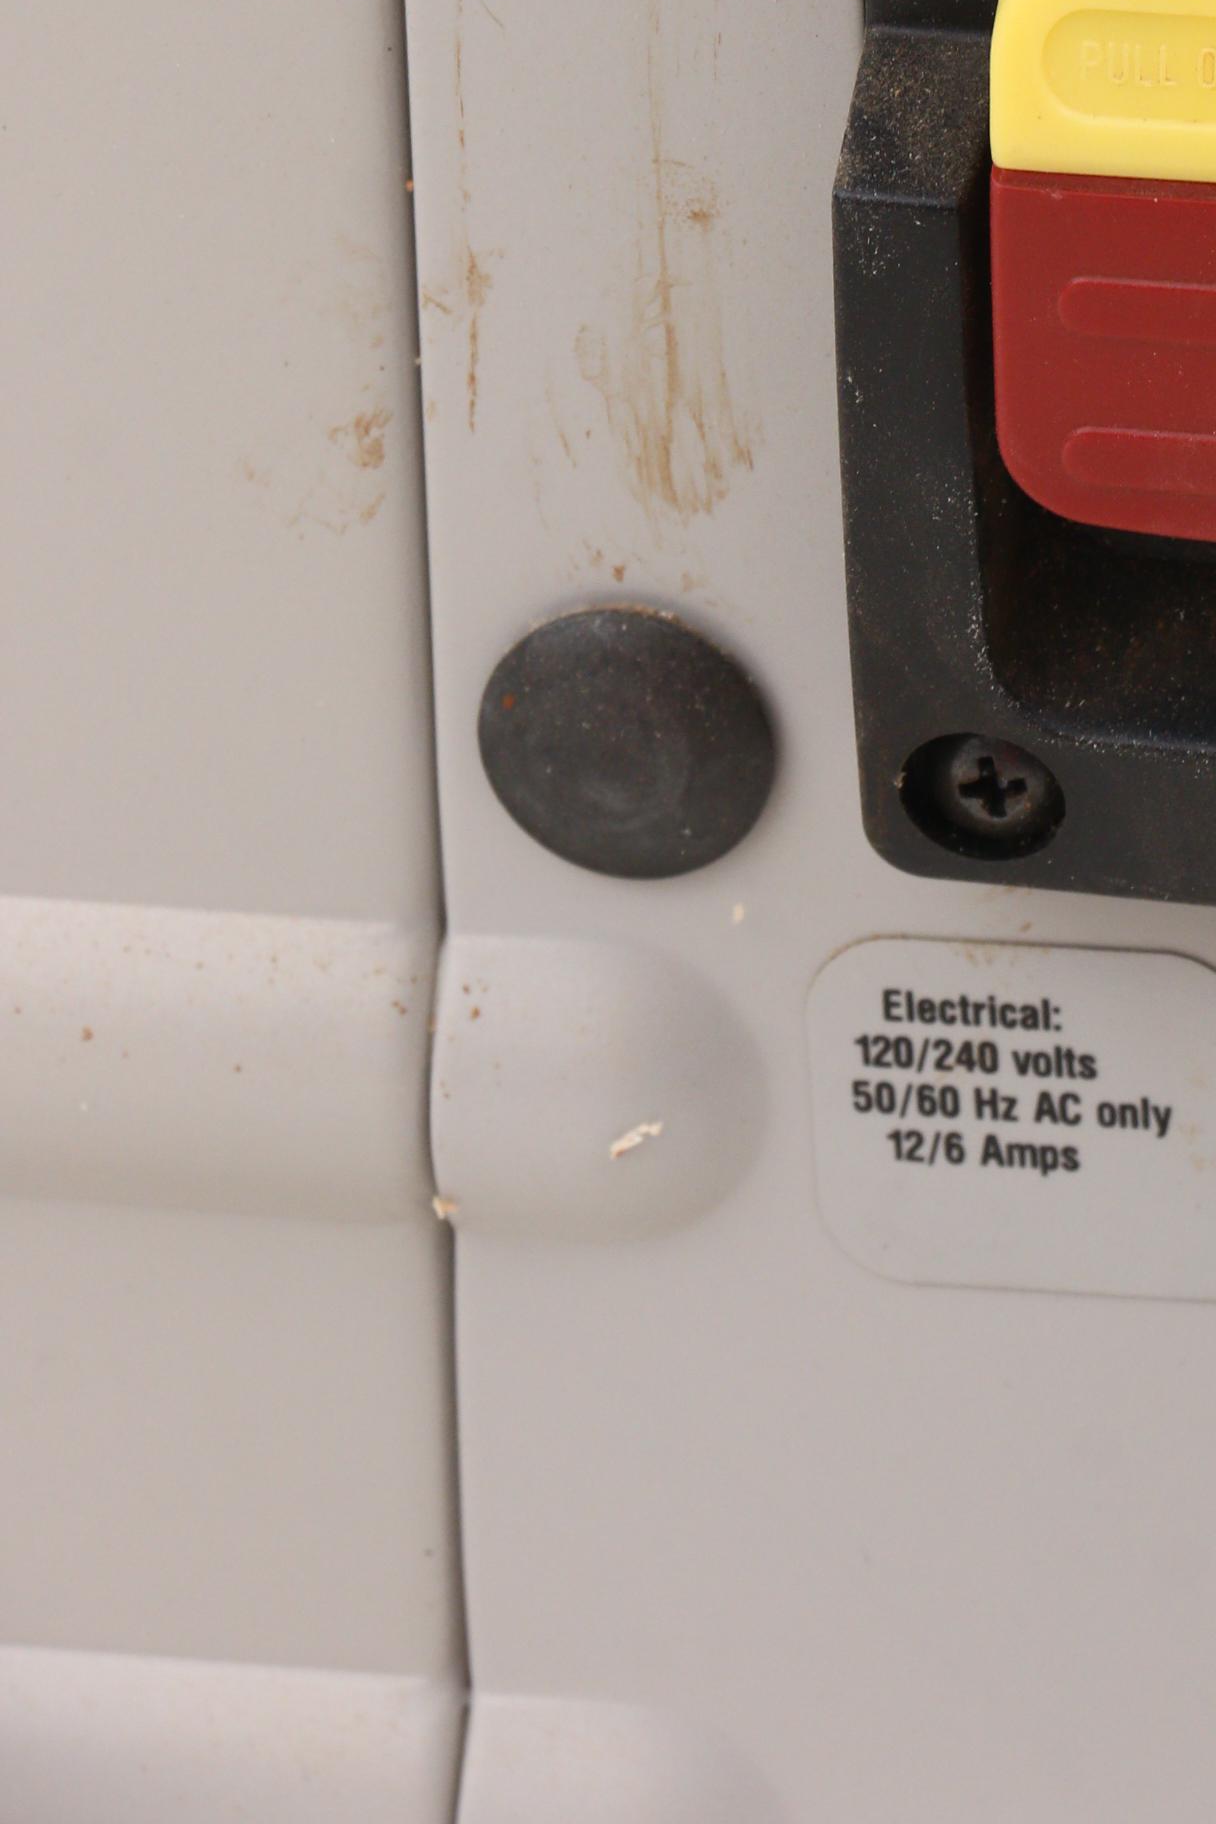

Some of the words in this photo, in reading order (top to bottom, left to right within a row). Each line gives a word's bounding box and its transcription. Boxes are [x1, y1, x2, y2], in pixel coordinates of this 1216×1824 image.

[1079, 40, 1177, 87] PULL
[882, 989, 1062, 1031] Electrical:
[854, 1035, 998, 1075] 120/240
[1013, 1046, 1097, 1080] volts
[852, 1080, 961, 1120] 50/60
[974, 1088, 1018, 1124] Hz
[1034, 1092, 1082, 1127] AC
[1096, 1097, 1173, 1139] only
[888, 1130, 966, 1166] 12/6
[981, 1134, 1081, 1177] Amps
